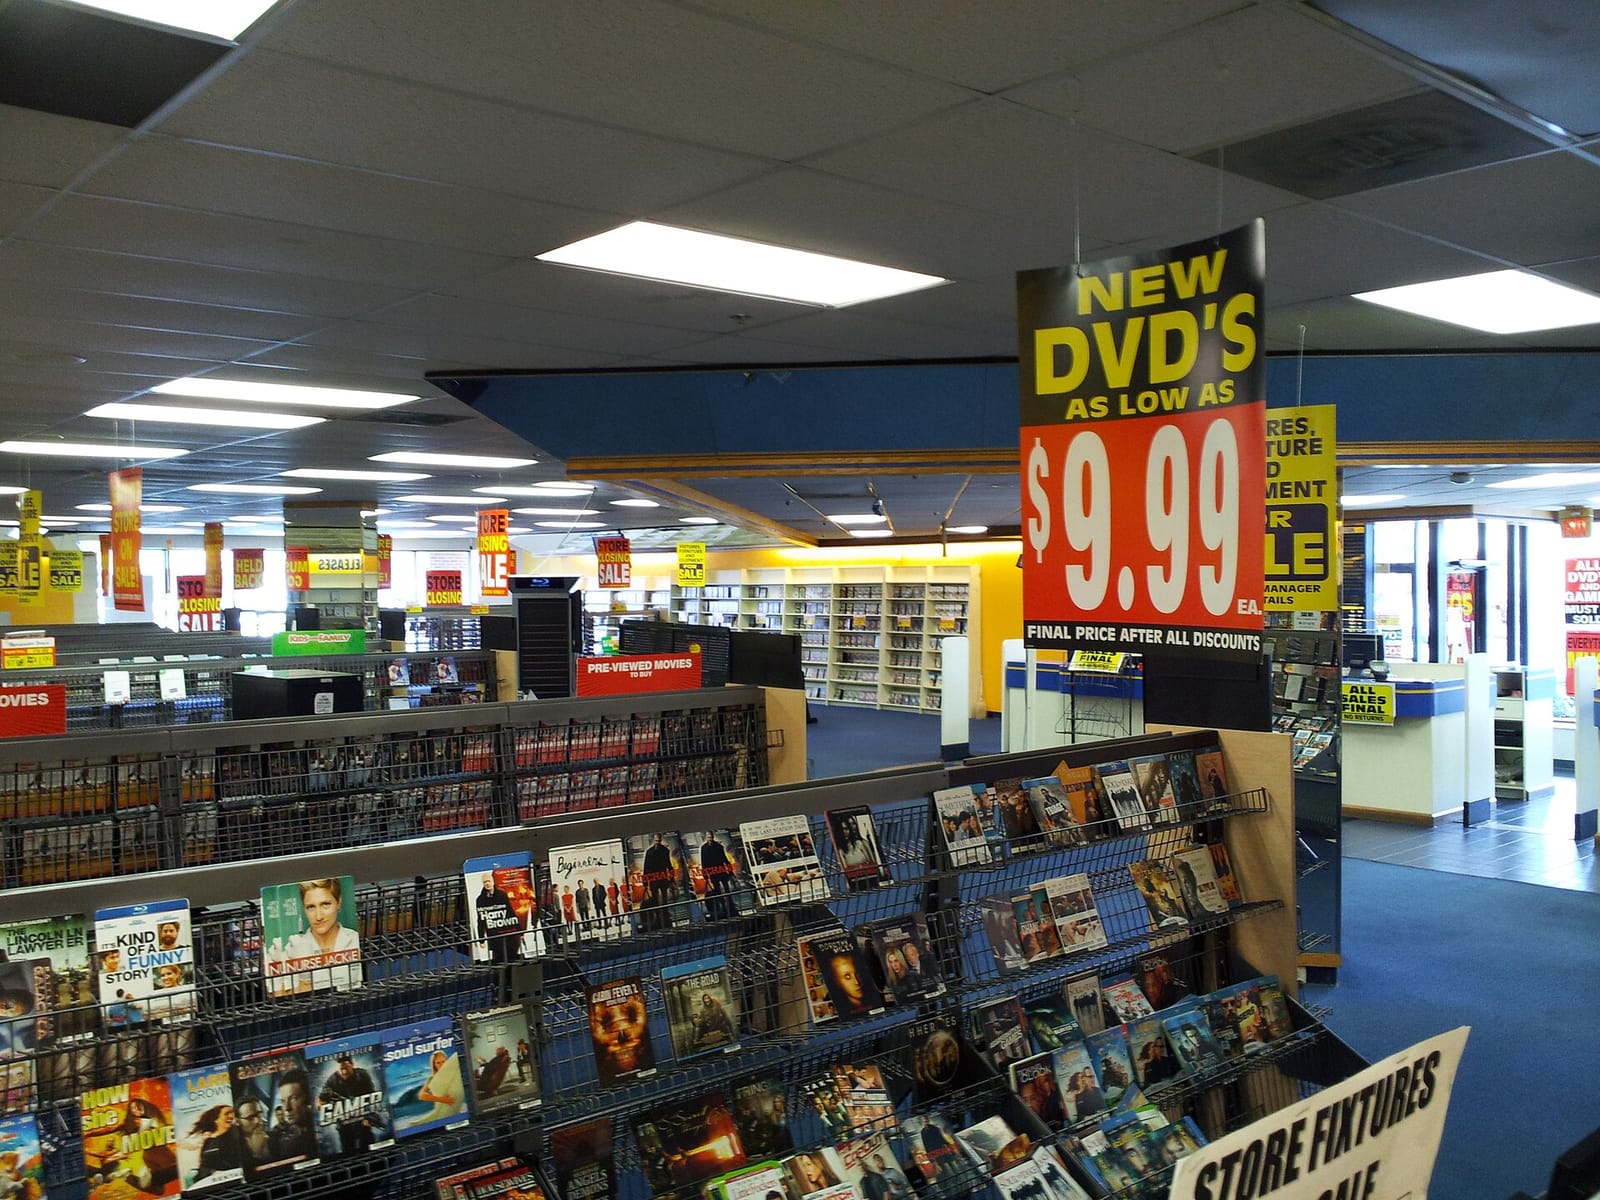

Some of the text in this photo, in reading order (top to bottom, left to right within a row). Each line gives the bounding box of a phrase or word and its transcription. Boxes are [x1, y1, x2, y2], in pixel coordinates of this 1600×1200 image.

[1077, 249, 1228, 316] NEW
[1034, 293, 1257, 395] DVD'S
[1065, 379, 1235, 420] AS LOW AS
[1028, 418, 1239, 616] $9.99
[120, 538, 133, 561] ON
[599, 541, 628, 552] STORE
[599, 553, 631, 563] CLOSING
[236, 560, 262, 573] HELD
[600, 563, 630, 584] SALE
[679, 568, 703, 579] SALE
[51, 576, 81, 586] SALE
[427, 576, 461, 590] STORE
[427, 591, 462, 605] CLOSING
[1237, 599, 1263, 616] EA.
[1027, 625, 1260, 651] FINAL PRICE AFTER ALL DISCOUNTS
[588, 659, 692, 674] PRE-VIEWED MOVIES
[1080, 655, 1112, 663] FINAL
[1350, 686, 1376, 695] ALL
[1342, 695, 1386, 705] SALES
[1342, 704, 1385, 714] FINAL
[481, 908, 508, 922] Harry
[487, 916, 520, 930] Brown
[7, 928, 26, 937] THE
[7, 930, 63, 946] LINCOLN
[116, 931, 156, 948] KIND
[7, 939, 64, 956] LAWYER
[127, 944, 157, 957] OF A
[128, 949, 185, 970] FUNNY
[285, 956, 322, 973] NURSE
[106, 968, 150, 984] STORY
[701, 973, 720, 987] ROAD
[384, 1036, 455, 1062] soul surfer
[82, 1083, 129, 1110] HOW
[319, 1092, 383, 1127] GAMER
[1308, 1050, 1441, 1174] FIXTURES
[81, 1109, 118, 1132] she
[121, 1126, 176, 1154] MOVE
